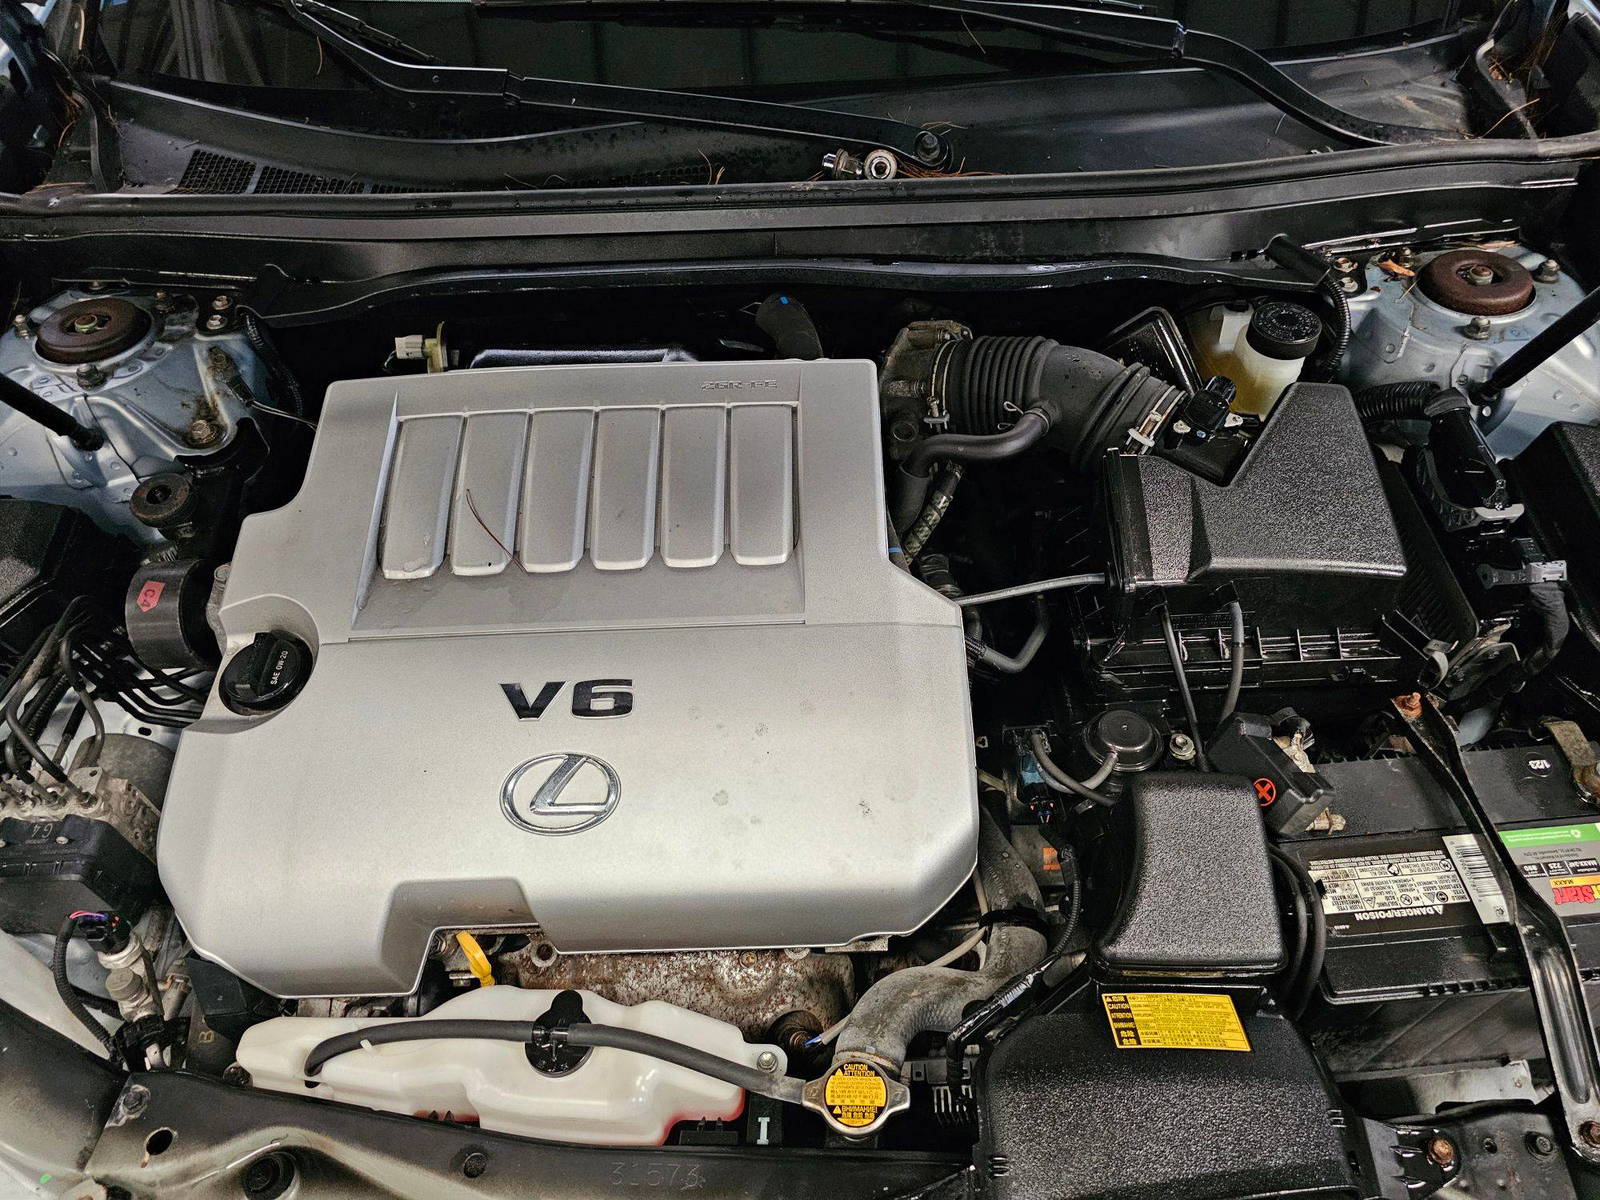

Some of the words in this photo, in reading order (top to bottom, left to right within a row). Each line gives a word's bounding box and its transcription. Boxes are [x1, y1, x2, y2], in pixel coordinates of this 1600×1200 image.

[270, 672, 281, 685] SAE
[499, 679, 634, 721] V6
[1354, 906, 1435, 920] DANGER/POISON
[843, 1063, 868, 1071] CAUTION
